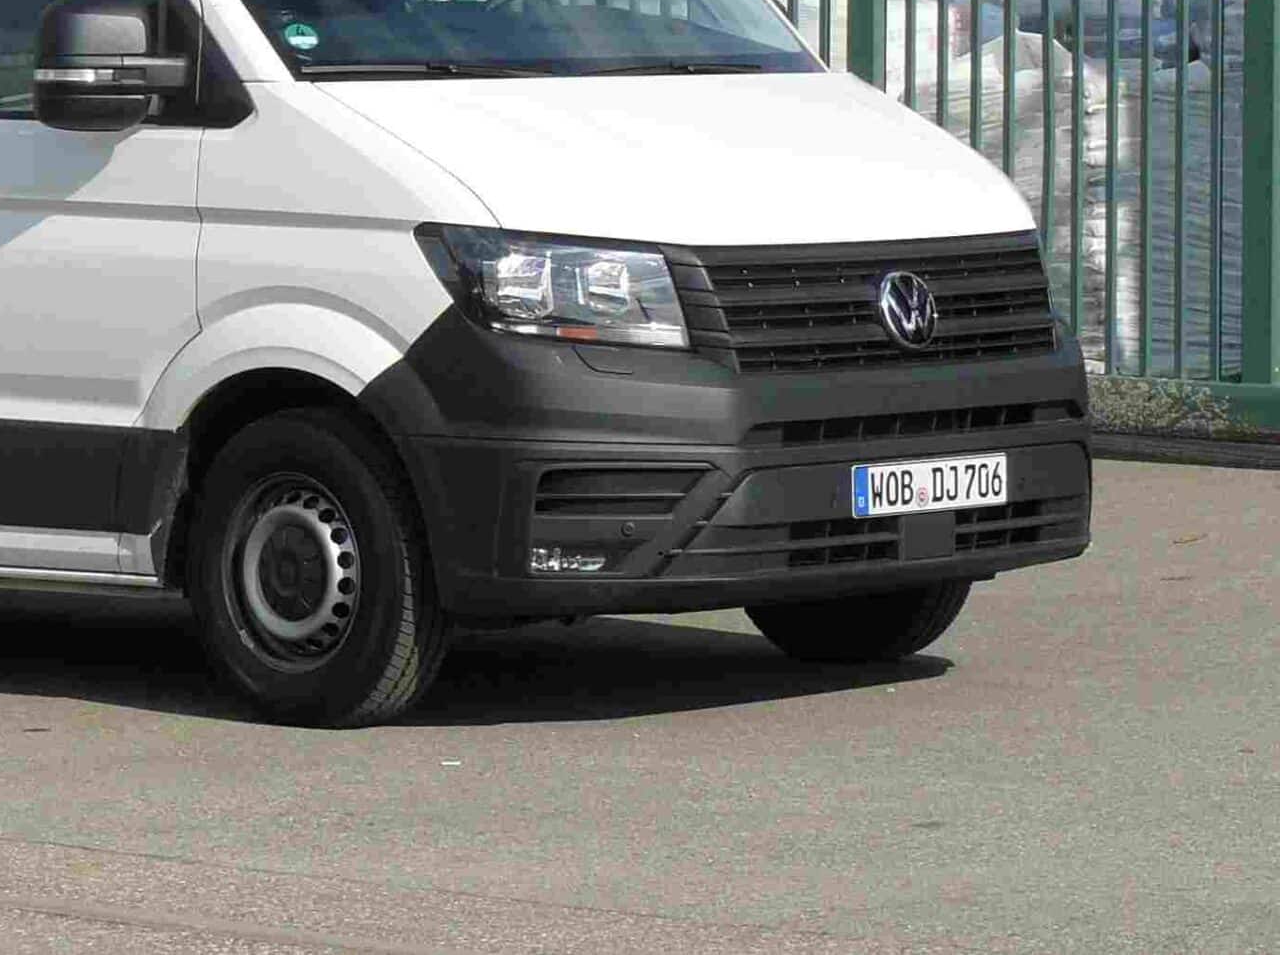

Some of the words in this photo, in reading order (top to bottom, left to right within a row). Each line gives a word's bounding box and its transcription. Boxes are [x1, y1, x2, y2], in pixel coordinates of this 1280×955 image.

[871, 469, 914, 508] WOB
[931, 465, 959, 503] DJ
[964, 462, 1002, 499] 706
